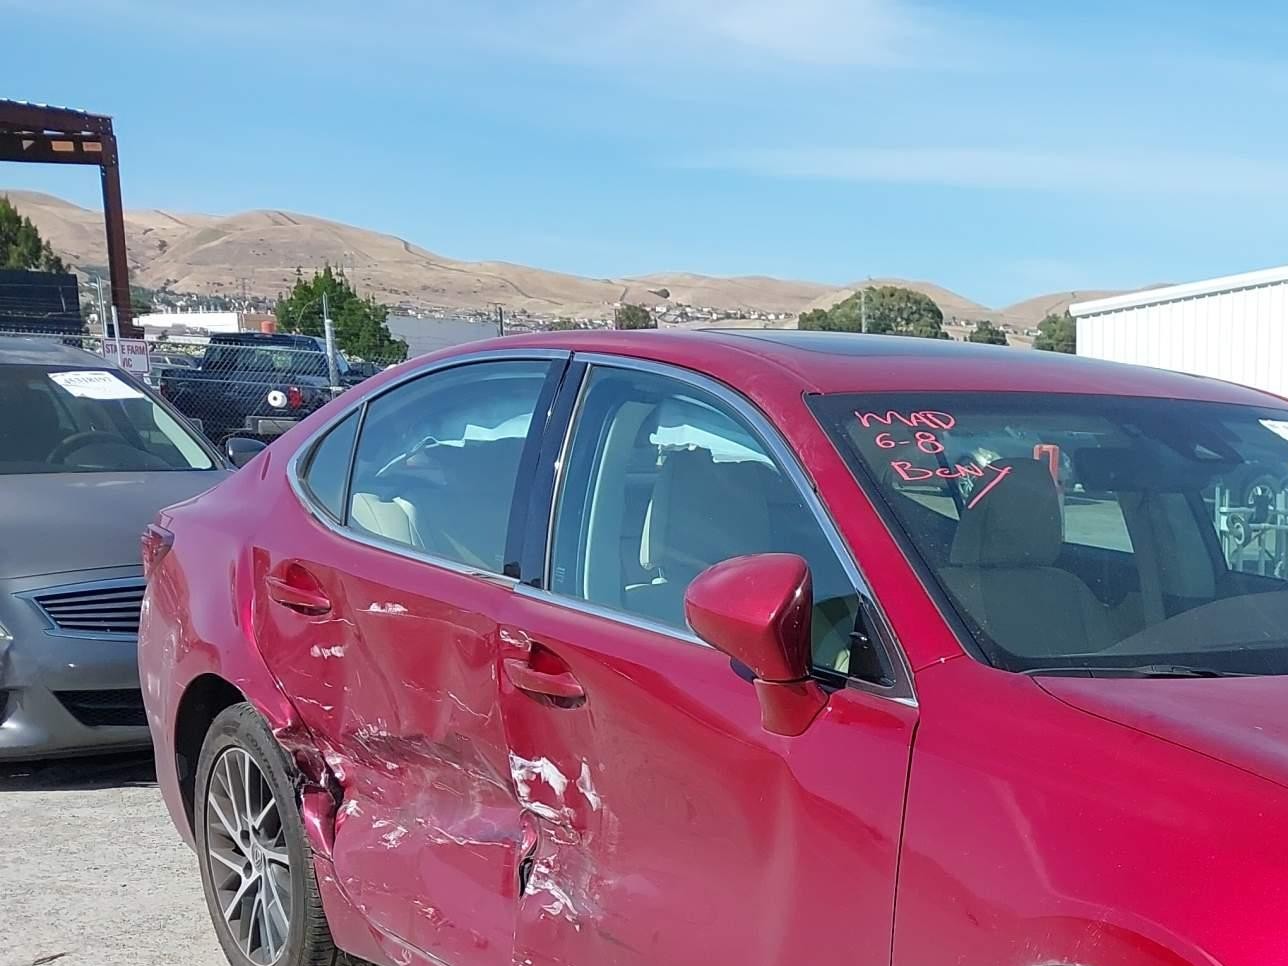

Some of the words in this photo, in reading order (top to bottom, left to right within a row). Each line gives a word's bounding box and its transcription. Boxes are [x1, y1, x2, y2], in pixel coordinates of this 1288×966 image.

[105, 343, 126, 354] STAE
[127, 345, 146, 355] FARM
[875, 431, 945, 454] 6-8
